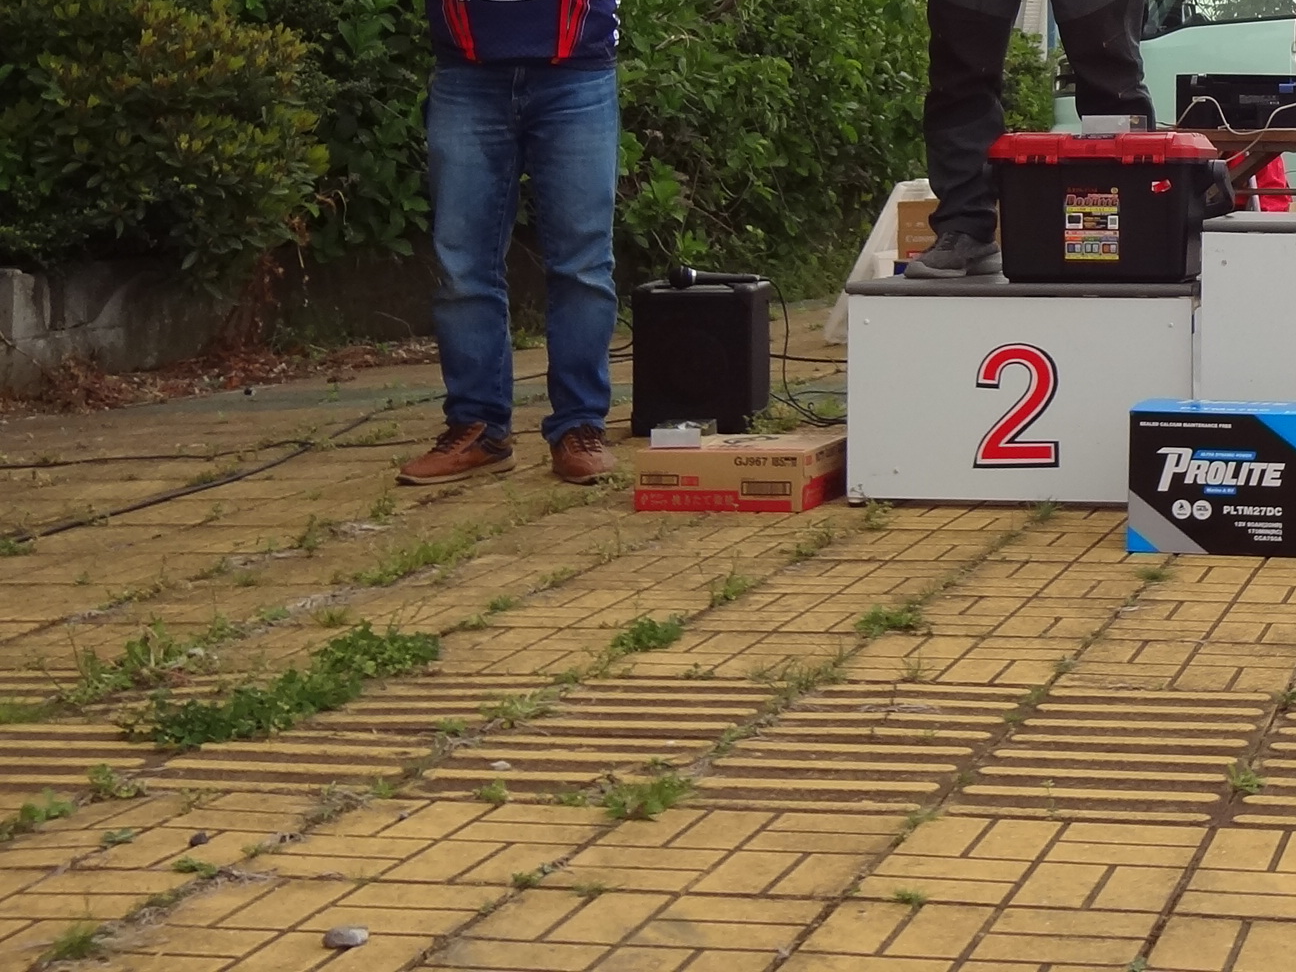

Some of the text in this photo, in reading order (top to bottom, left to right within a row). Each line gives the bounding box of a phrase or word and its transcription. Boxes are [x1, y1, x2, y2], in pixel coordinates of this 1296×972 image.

[973, 342, 1060, 469] 2
[1156, 446, 1286, 492] PROLITE
[1222, 505, 1283, 517] PLTM27DC
